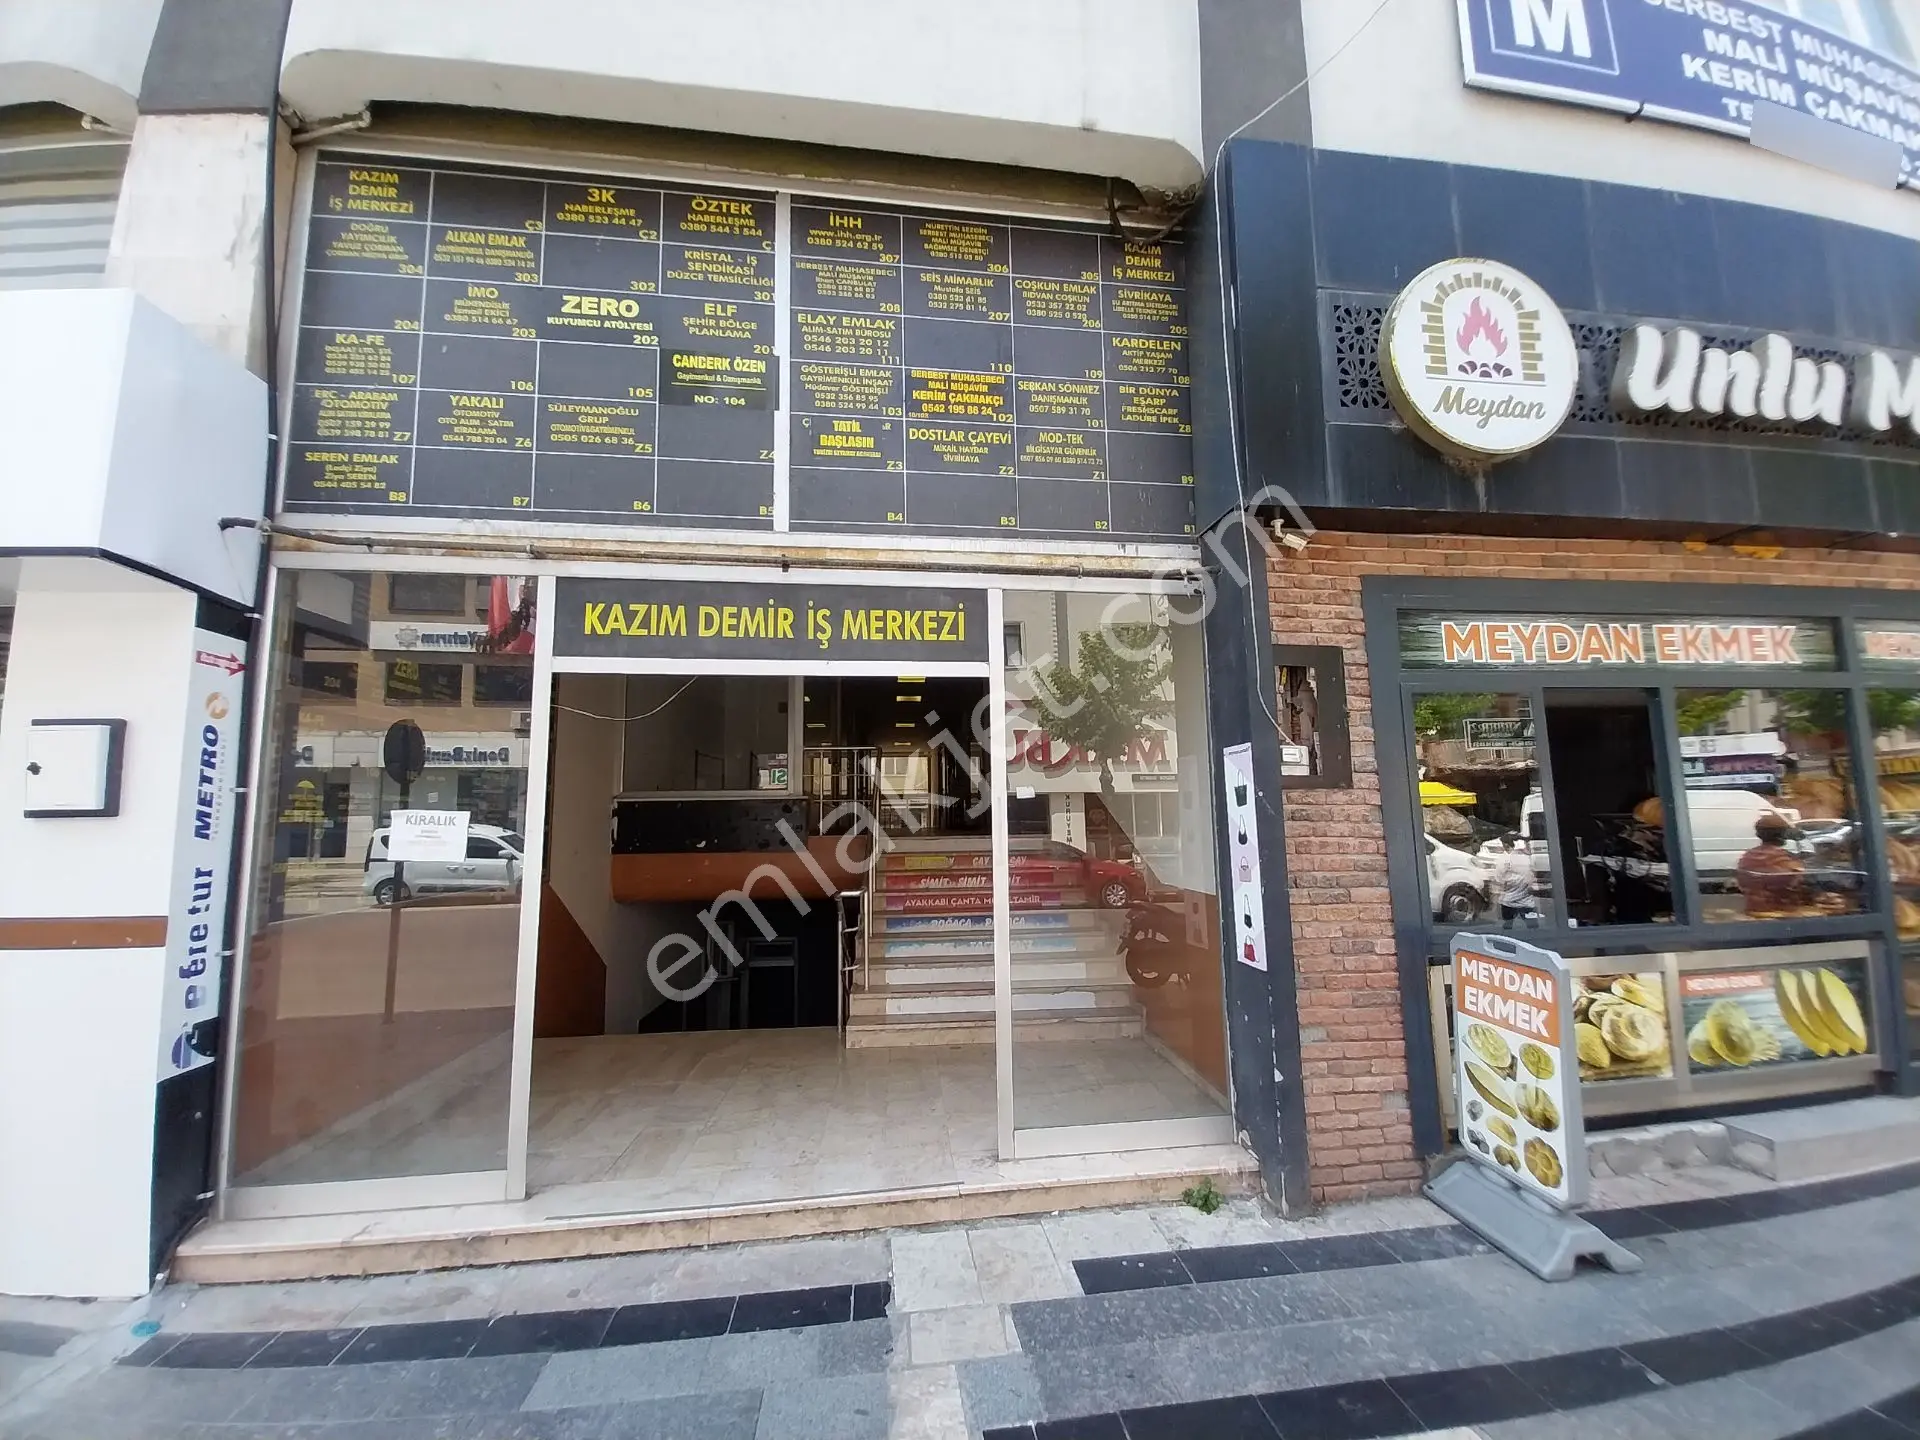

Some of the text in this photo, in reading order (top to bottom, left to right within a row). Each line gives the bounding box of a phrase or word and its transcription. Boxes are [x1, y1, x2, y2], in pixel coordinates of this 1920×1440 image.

[1510, 0, 1592, 58] M
[1702, 28, 1788, 74] MALİ
[1681, 53, 1797, 107] KERİM
[350, 171, 399, 184] KAZIM
[348, 183, 398, 198] DEMİR
[587, 188, 616, 204] 3K
[329, 196, 413, 214] İŞ MERKEZİ
[564, 203, 636, 217] HABERLEŞME
[691, 196, 753, 216] ÖZTEK
[557, 212, 584, 222] 0380
[611, 217, 626, 226] 44
[628, 218, 643, 227] 47
[687, 213, 756, 228] HABERLEŞME
[829, 212, 862, 229] İHH
[525, 220, 543, 232] Ç3
[445, 231, 527, 248] ALKAN EMLAK
[639, 230, 657, 241] Ç2
[807, 237, 884, 251] 0380 524 62 59
[1124, 242, 1161, 255] KAZIM
[684, 249, 734, 263] KRİSTAL
[879, 254, 900, 263] 307
[1125, 255, 1162, 268] DEMİR
[398, 264, 423, 274] 304
[987, 264, 1009, 273] 306
[1112, 266, 1175, 282] İŞ MERKEZİ
[515, 272, 538, 283] 303
[666, 270, 704, 281] DÜZCE
[1081, 272, 1099, 280] 305
[468, 283, 499, 299] İMO
[630, 281, 656, 292] 302
[1014, 279, 1096, 294] COŞKUN EMLAK
[1118, 288, 1172, 303] SİVRİKAYA
[561, 294, 640, 318] ZERO
[704, 303, 738, 317] ELF
[879, 303, 900, 313] 208
[797, 313, 896, 330] ELAY EMLAK
[988, 312, 1010, 321] 207
[394, 320, 420, 330] 204
[547, 317, 653, 331] KUYUMCU ATÖLYESİ
[682, 316, 758, 330] ŞEHİR BÖLGE
[1082, 319, 1100, 328] 206
[512, 328, 536, 338] 203
[689, 327, 752, 339] PLANLAMA
[1170, 326, 1188, 334] 205
[335, 334, 385, 346] KA-FE
[632, 334, 659, 345] 202
[1112, 337, 1182, 351] KARDELEN
[734, 356, 766, 373] ÖZEN
[880, 355, 900, 365] 111
[860, 368, 892, 378] EMLAK
[990, 362, 1012, 372] 110
[392, 374, 416, 384] 107
[1084, 369, 1103, 378] 109
[1173, 375, 1190, 384] 108
[510, 380, 534, 391] 106
[1017, 380, 1100, 395] SERKAN SÖNMEZ
[1119, 385, 1179, 397] BİR DÜNYA
[628, 387, 653, 398] 105
[912, 389, 946, 402] KERİM
[450, 395, 504, 409] YAKALI
[694, 394, 746, 406] NO: 104
[1134, 397, 1166, 408] EŞARP
[881, 407, 902, 416] 103
[1432, 385, 1547, 429] Meydan
[578, 415, 609, 424] GRUP
[992, 413, 1013, 423] 102
[1086, 419, 1104, 428] 101
[832, 419, 862, 433] TATİL
[1178, 424, 1191, 433] Z8
[393, 432, 411, 442] Z7
[514, 437, 532, 447] Z6
[820, 434, 874, 449] BAŞLASIN
[909, 428, 1012, 445] DOSTLAR ÇAYEVİ
[1039, 432, 1084, 444] MOD-TEK
[634, 444, 653, 453] Z5
[304, 452, 399, 464] SEREN EMLAK
[886, 460, 903, 470] Z3
[999, 466, 1014, 475] Z2
[1092, 471, 1105, 480] Z1
[1182, 476, 1194, 484] B9
[388, 491, 407, 502] B8
[512, 497, 529, 507] B7
[633, 501, 650, 511] B6
[887, 512, 903, 522] B4
[1000, 516, 1016, 526] B3
[1095, 521, 1108, 530] B2
[1184, 525, 1196, 533] B1
[584, 598, 966, 649] KAZIM DEMİR İŞ MERKEZİ
[1441, 621, 1802, 665] MEYDAN EKMEK
[194, 723, 219, 841] METRO
[405, 814, 457, 826] KIRALIK
[1460, 956, 1554, 1003] MEYDAN
[1463, 990, 1551, 1038] EKMEK
